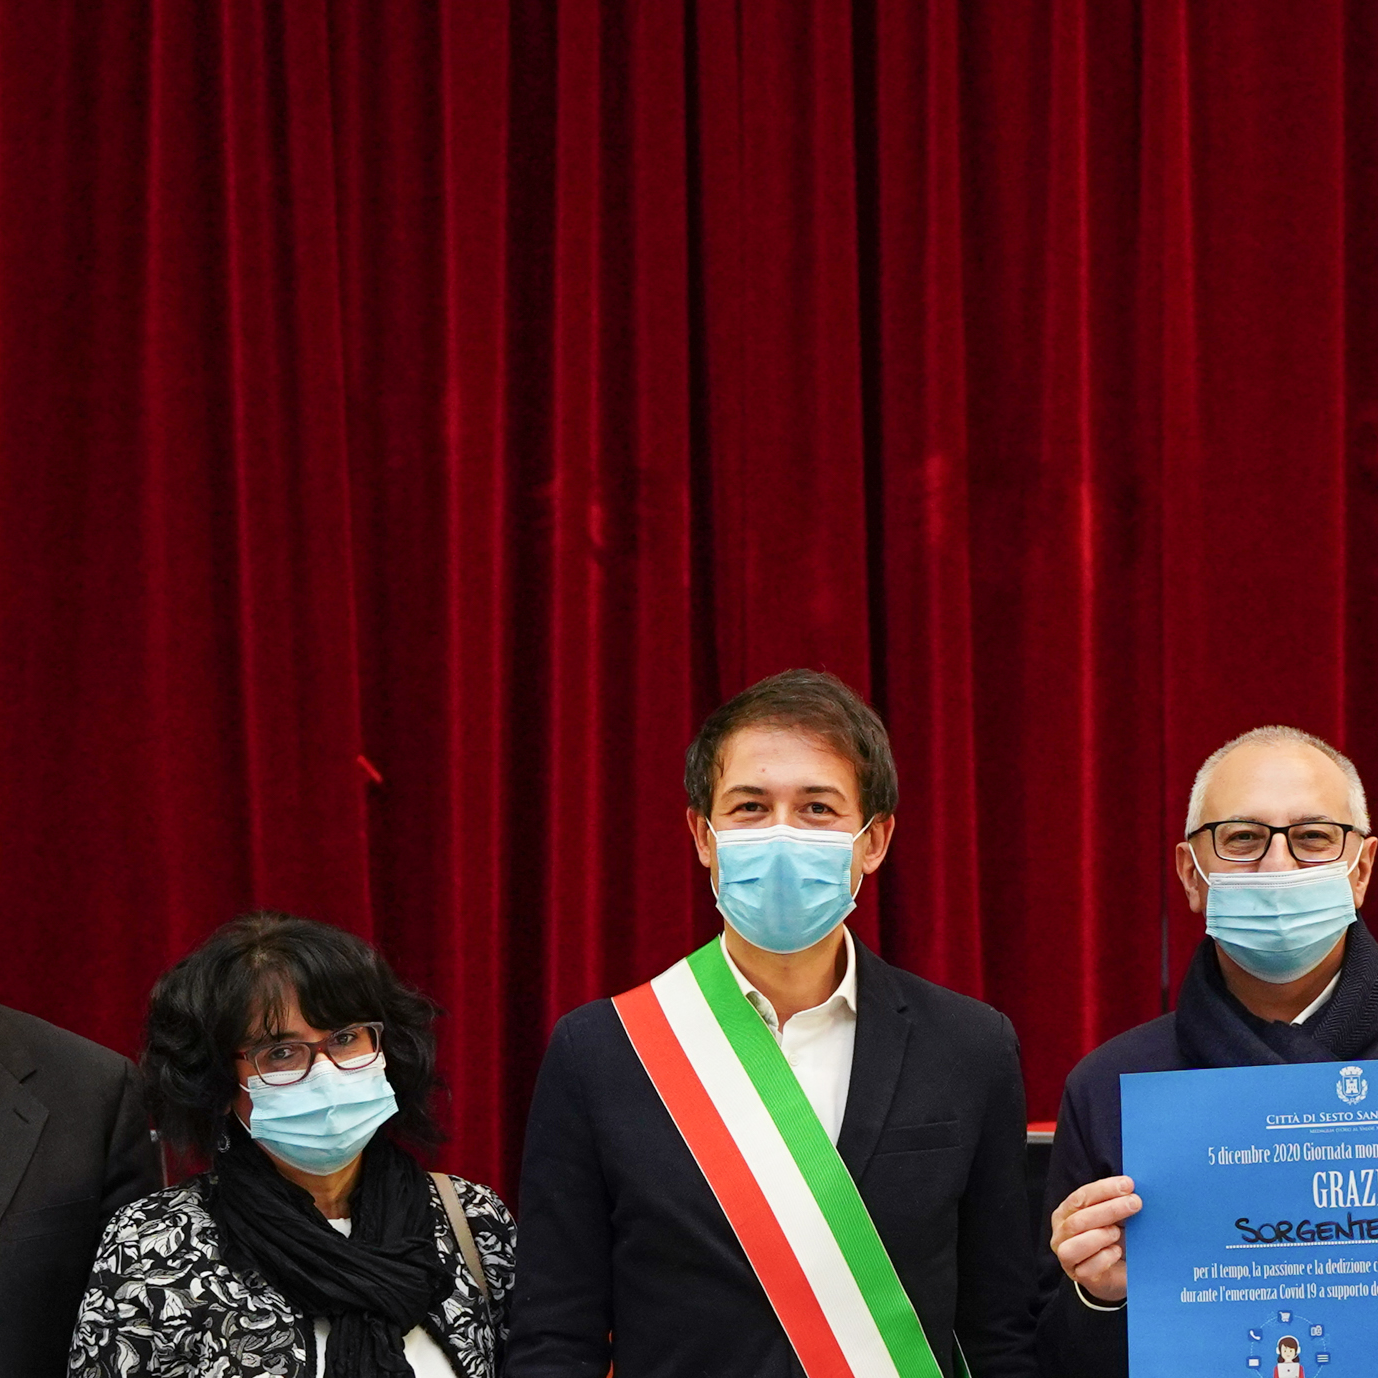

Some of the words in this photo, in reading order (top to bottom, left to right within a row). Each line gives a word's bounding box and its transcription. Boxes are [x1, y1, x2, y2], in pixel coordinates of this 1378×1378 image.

[1319, 1111, 1354, 1122] SESTO
[1356, 1110, 1378, 1120] SAN
[1208, 1147, 1215, 1165] 5
[1218, 1145, 1271, 1165] dicembre
[1273, 1143, 1300, 1163] 2020
[1303, 1142, 1352, 1161] Giornata
[1193, 1266, 1209, 1281] per
[1211, 1263, 1218, 1278] il
[1220, 1264, 1251, 1281] tempo,
[1252, 1261, 1262, 1277] la
[1263, 1260, 1304, 1279] passione
[1306, 1264, 1312, 1275] e
[1314, 1259, 1323, 1275] la
[1325, 1258, 1371, 1274] dedizione
[1180, 1287, 1218, 1303] durante
[1219, 1285, 1278, 1302] l'emergenza
[1279, 1283, 1305, 1299] Covid
[1306, 1282, 1317, 1299] 19
[1319, 1286, 1325, 1298] a
[1326, 1283, 1369, 1300] supporto
